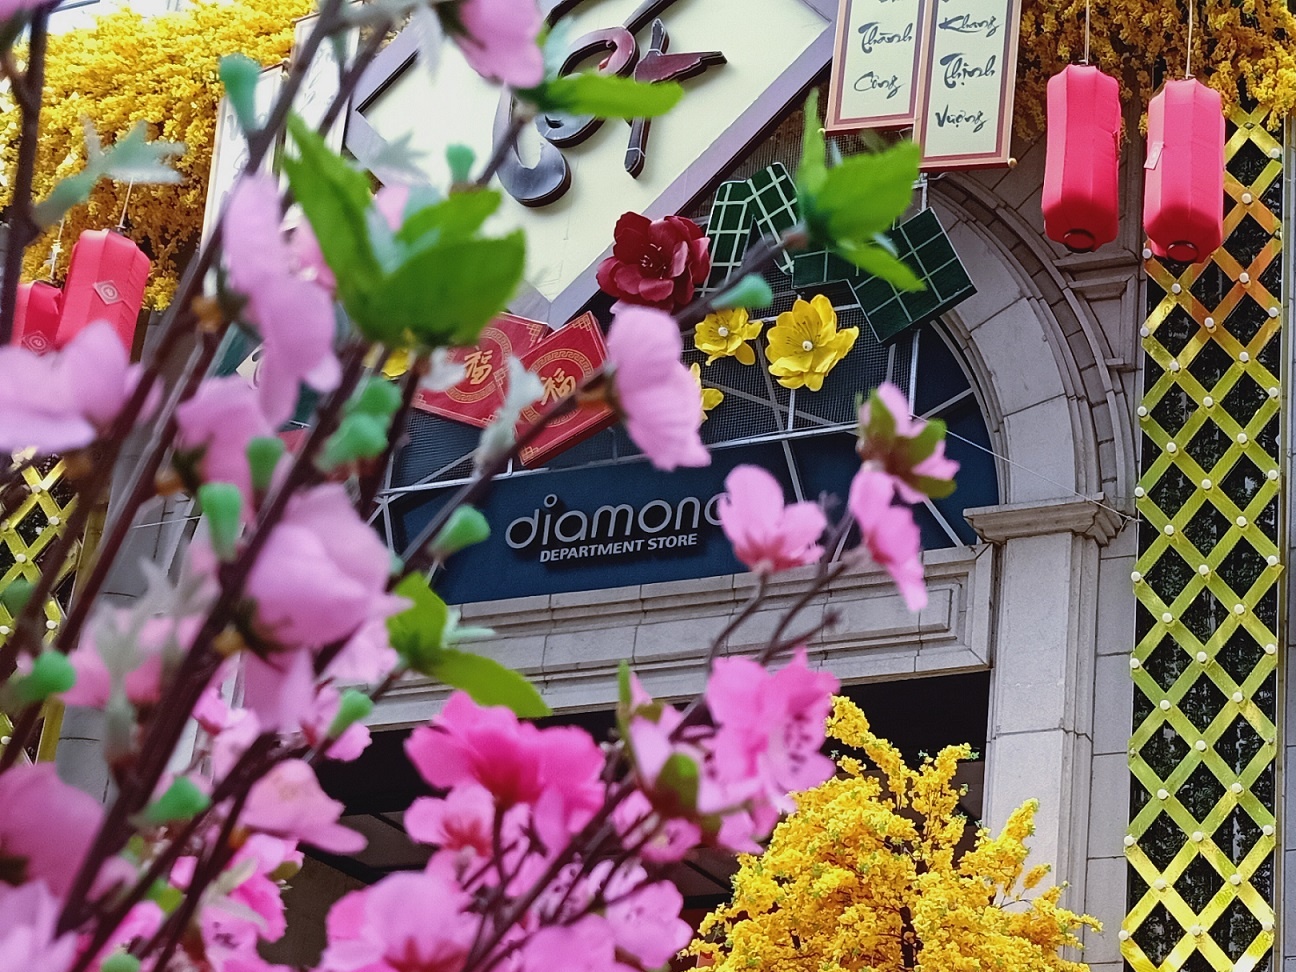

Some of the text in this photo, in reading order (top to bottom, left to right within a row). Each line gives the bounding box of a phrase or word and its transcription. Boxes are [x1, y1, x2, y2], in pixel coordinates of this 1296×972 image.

[464, 345, 493, 385] 福
[541, 367, 577, 405] 福
[540, 533, 698, 563] DEPARTMENT STORE
